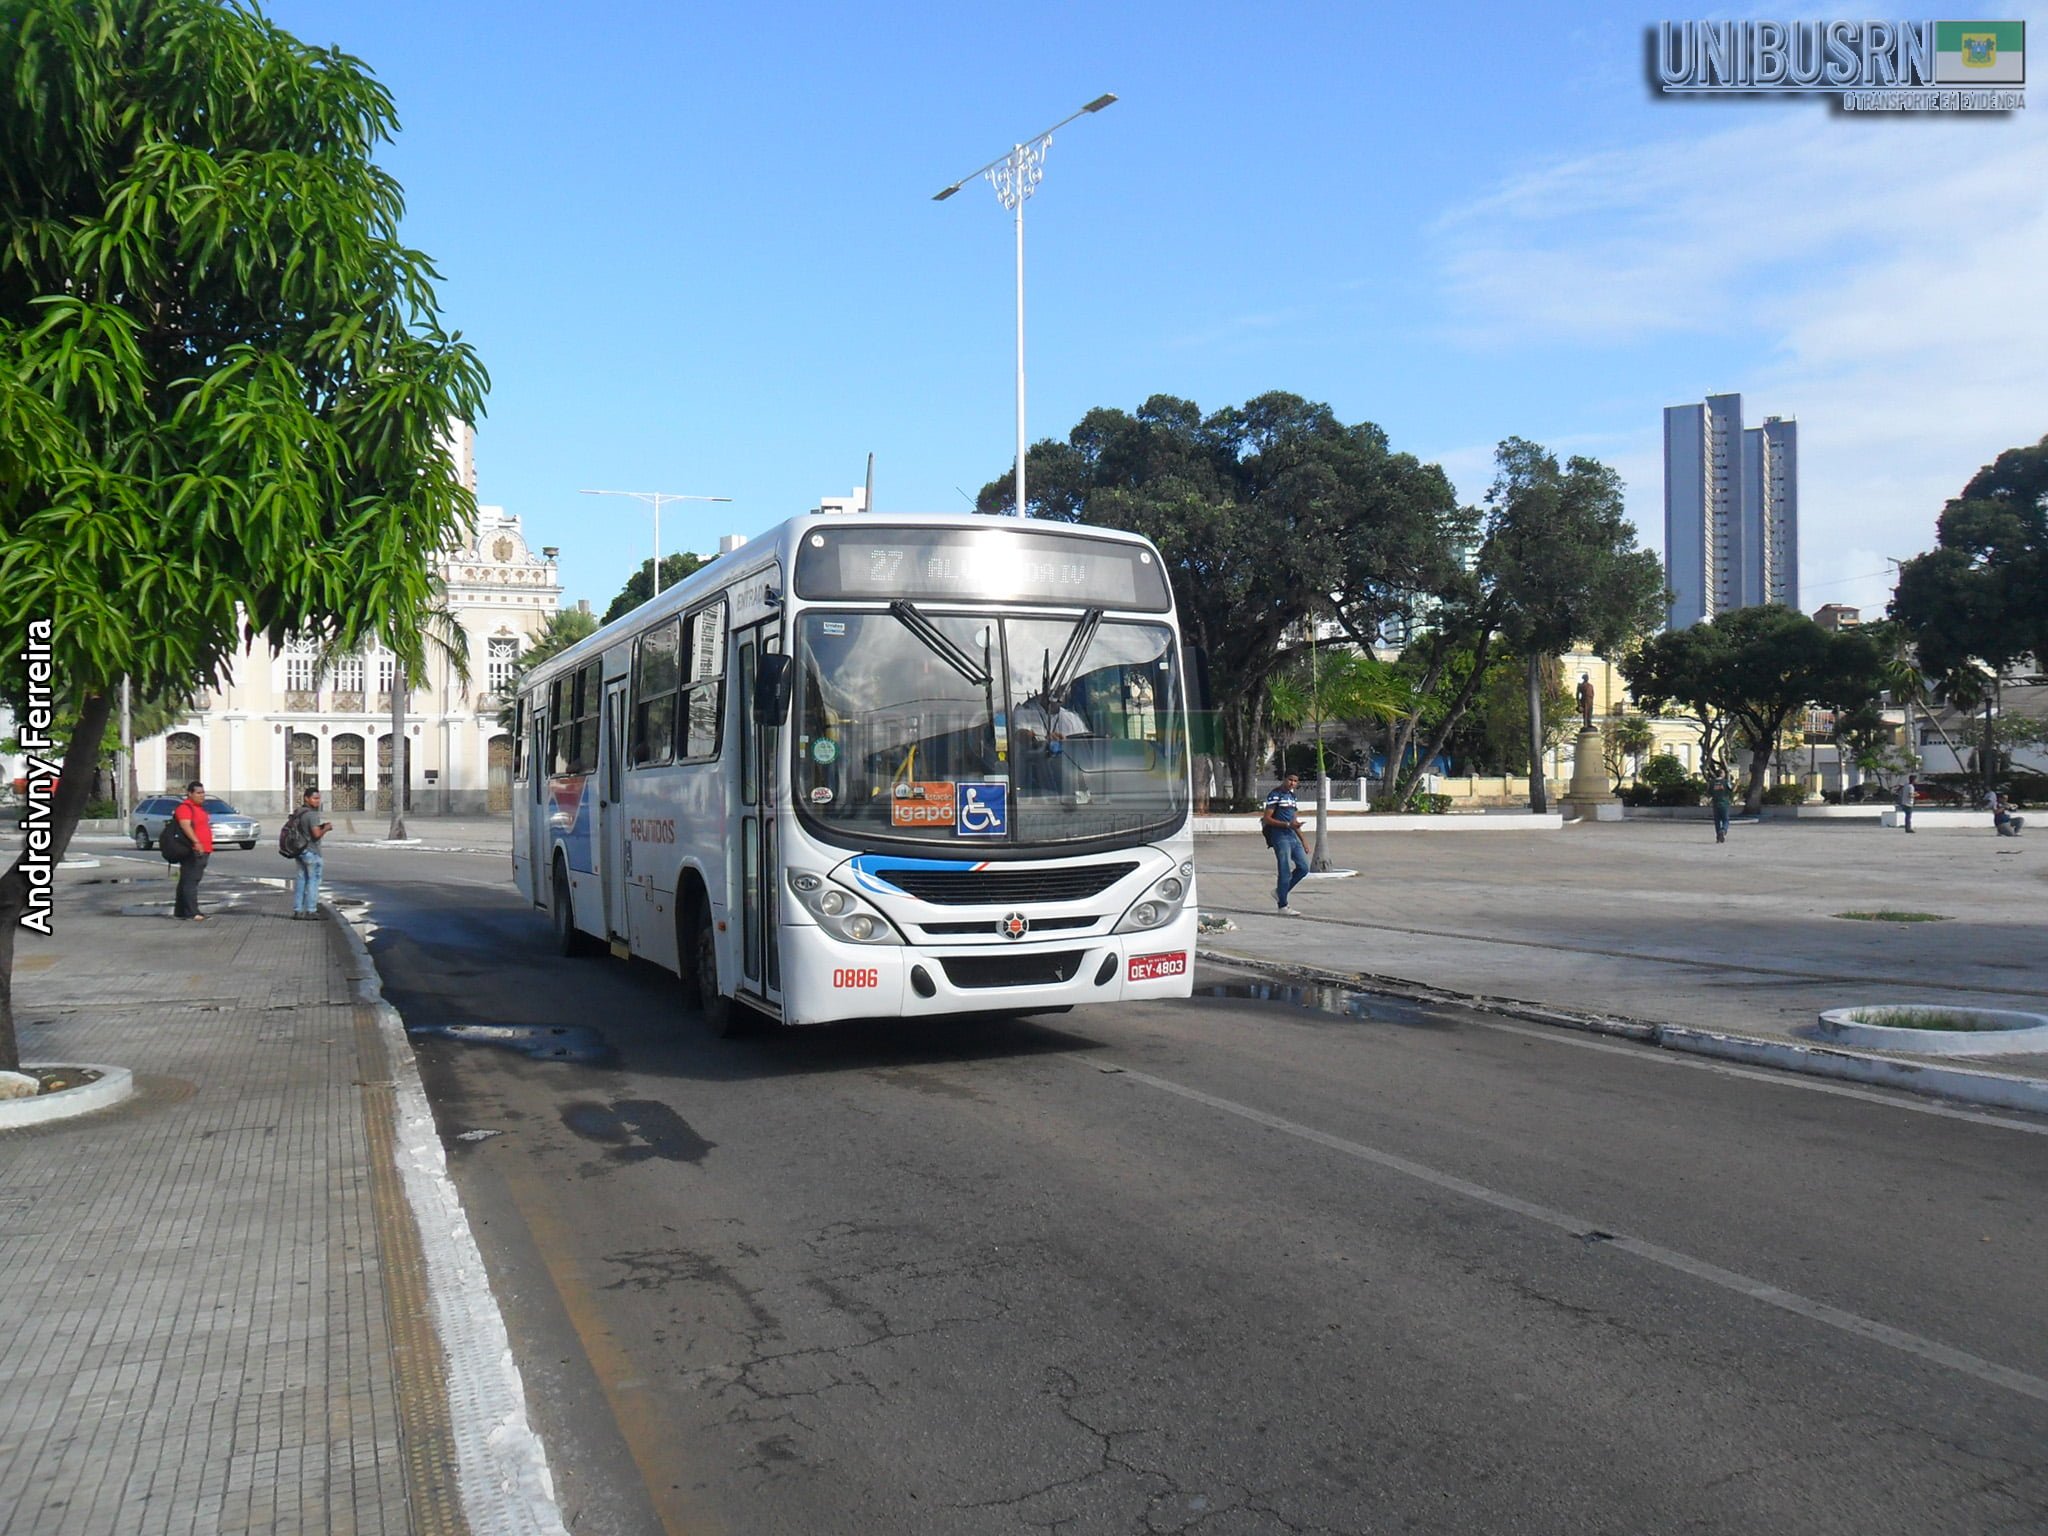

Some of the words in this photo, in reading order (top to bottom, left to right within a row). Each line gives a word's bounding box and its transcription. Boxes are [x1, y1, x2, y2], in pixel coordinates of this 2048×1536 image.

[870, 550, 903, 582] 27
[895, 803, 953, 822] Igapó
[833, 968, 878, 988] 0886
